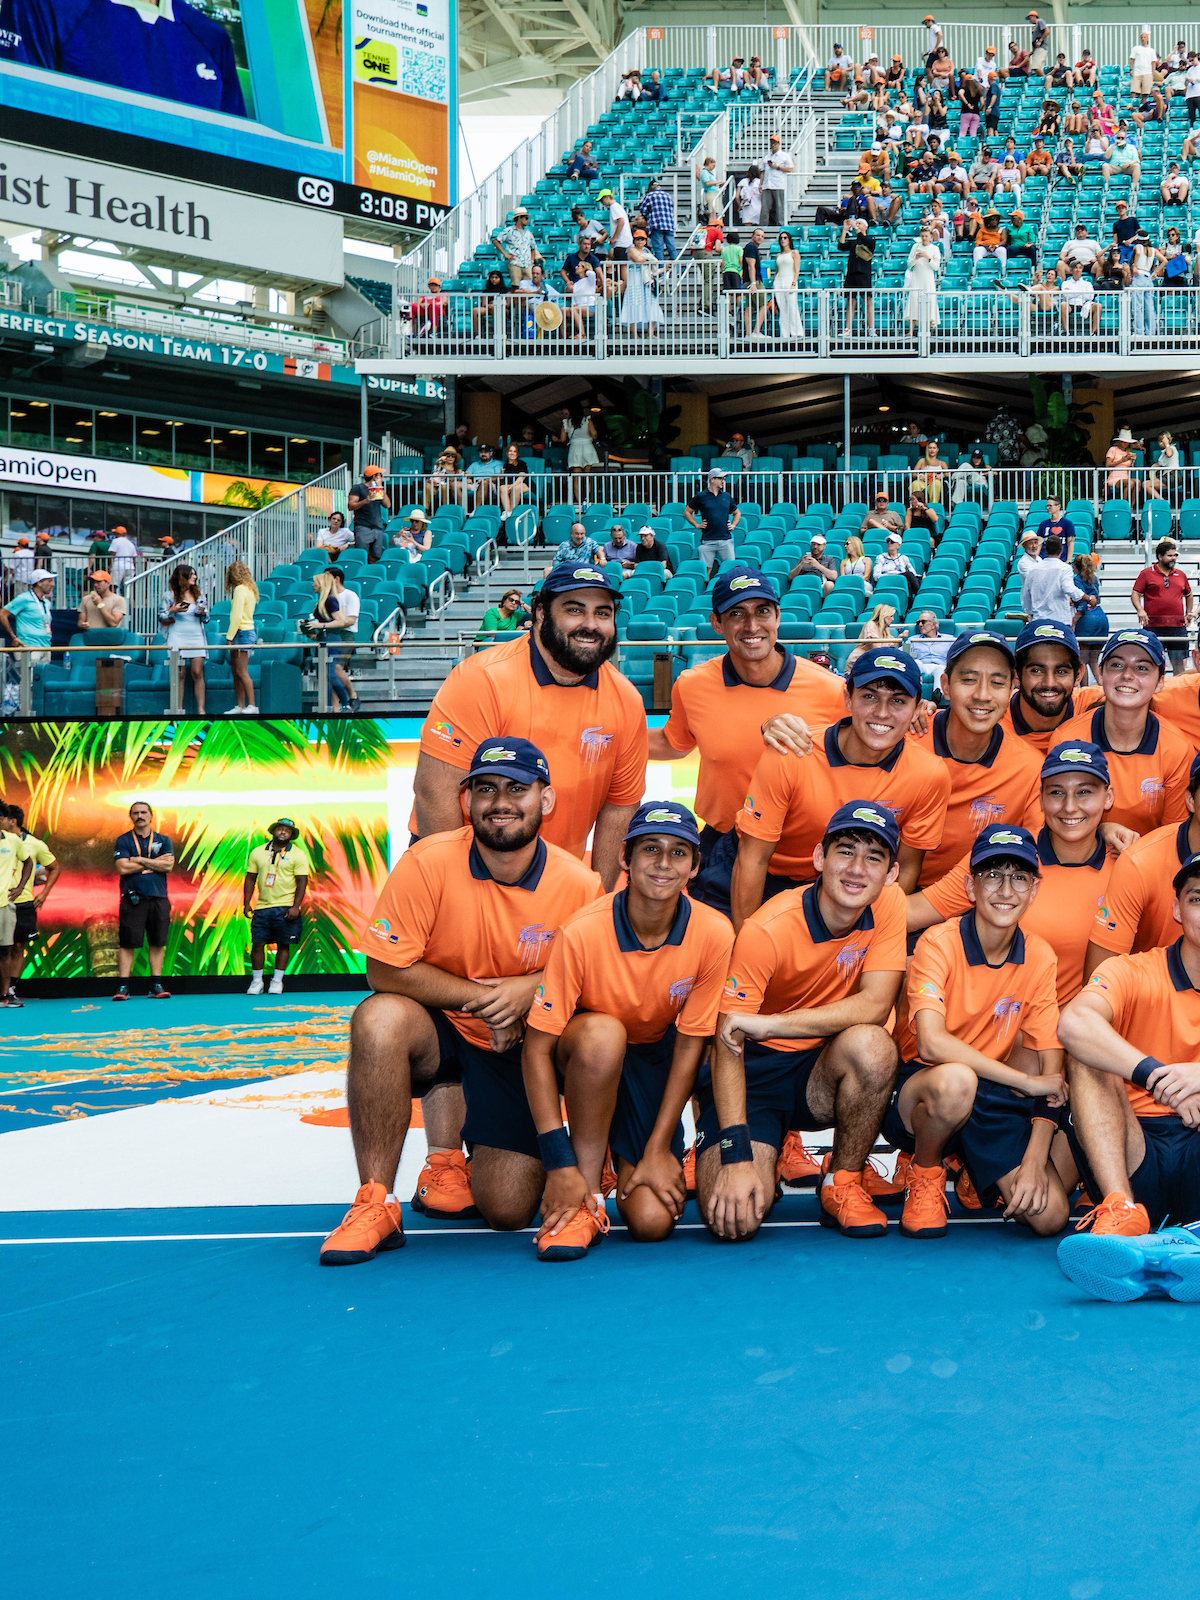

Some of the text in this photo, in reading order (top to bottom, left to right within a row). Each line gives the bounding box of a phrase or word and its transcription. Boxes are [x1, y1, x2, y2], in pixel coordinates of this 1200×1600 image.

[356, 9, 445, 41] Download the official
[367, 23, 435, 49] tournament app
[362, 50, 390, 64] TENNIS
[363, 58, 390, 75] ONE
[366, 150, 438, 175] @MiamiOpen
[369, 164, 436, 188] #MiamiOpen
[0, 162, 213, 242] ist Health
[302, 181, 330, 203] CC
[360, 191, 446, 228] 3:08 PM
[0, 312, 268, 371] ERFECT SEASON TEAM 17-0
[367, 375, 419, 396] SUPER
